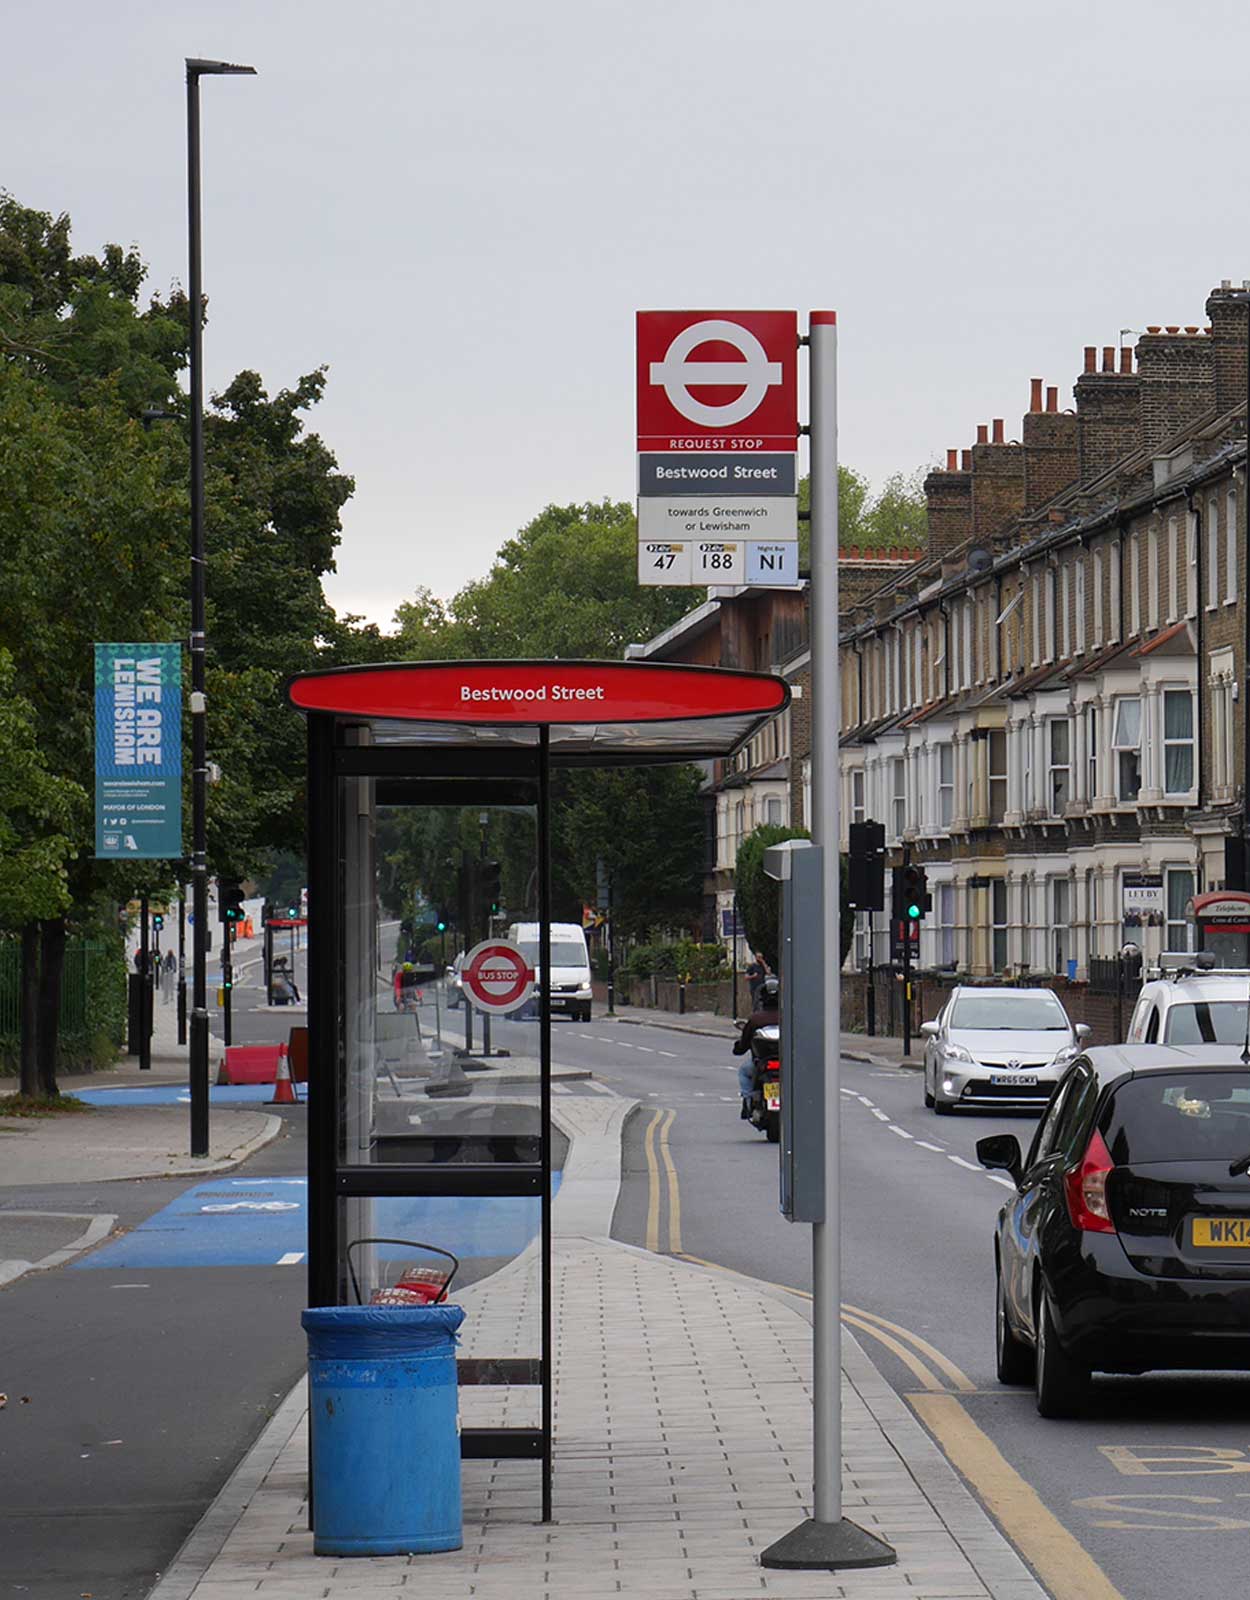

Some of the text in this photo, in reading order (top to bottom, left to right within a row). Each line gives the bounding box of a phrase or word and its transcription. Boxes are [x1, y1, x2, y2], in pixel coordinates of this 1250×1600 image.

[669, 439, 764, 450] REQUEST STOP
[655, 465, 778, 479] Bestwood Street
[667, 506, 769, 518] towards Greenwich
[684, 520, 751, 532] or Lewisham
[653, 554, 676, 570] 47
[702, 553, 733, 570] 188
[759, 554, 784, 570] N1
[460, 685, 605, 701] Bestwood Street
[114, 658, 136, 766] LEWISHAM
[136, 657, 162, 765] WE ARE
[477, 970, 520, 980] BUS STOP
[1129, 1208, 1168, 1217] NOTE
